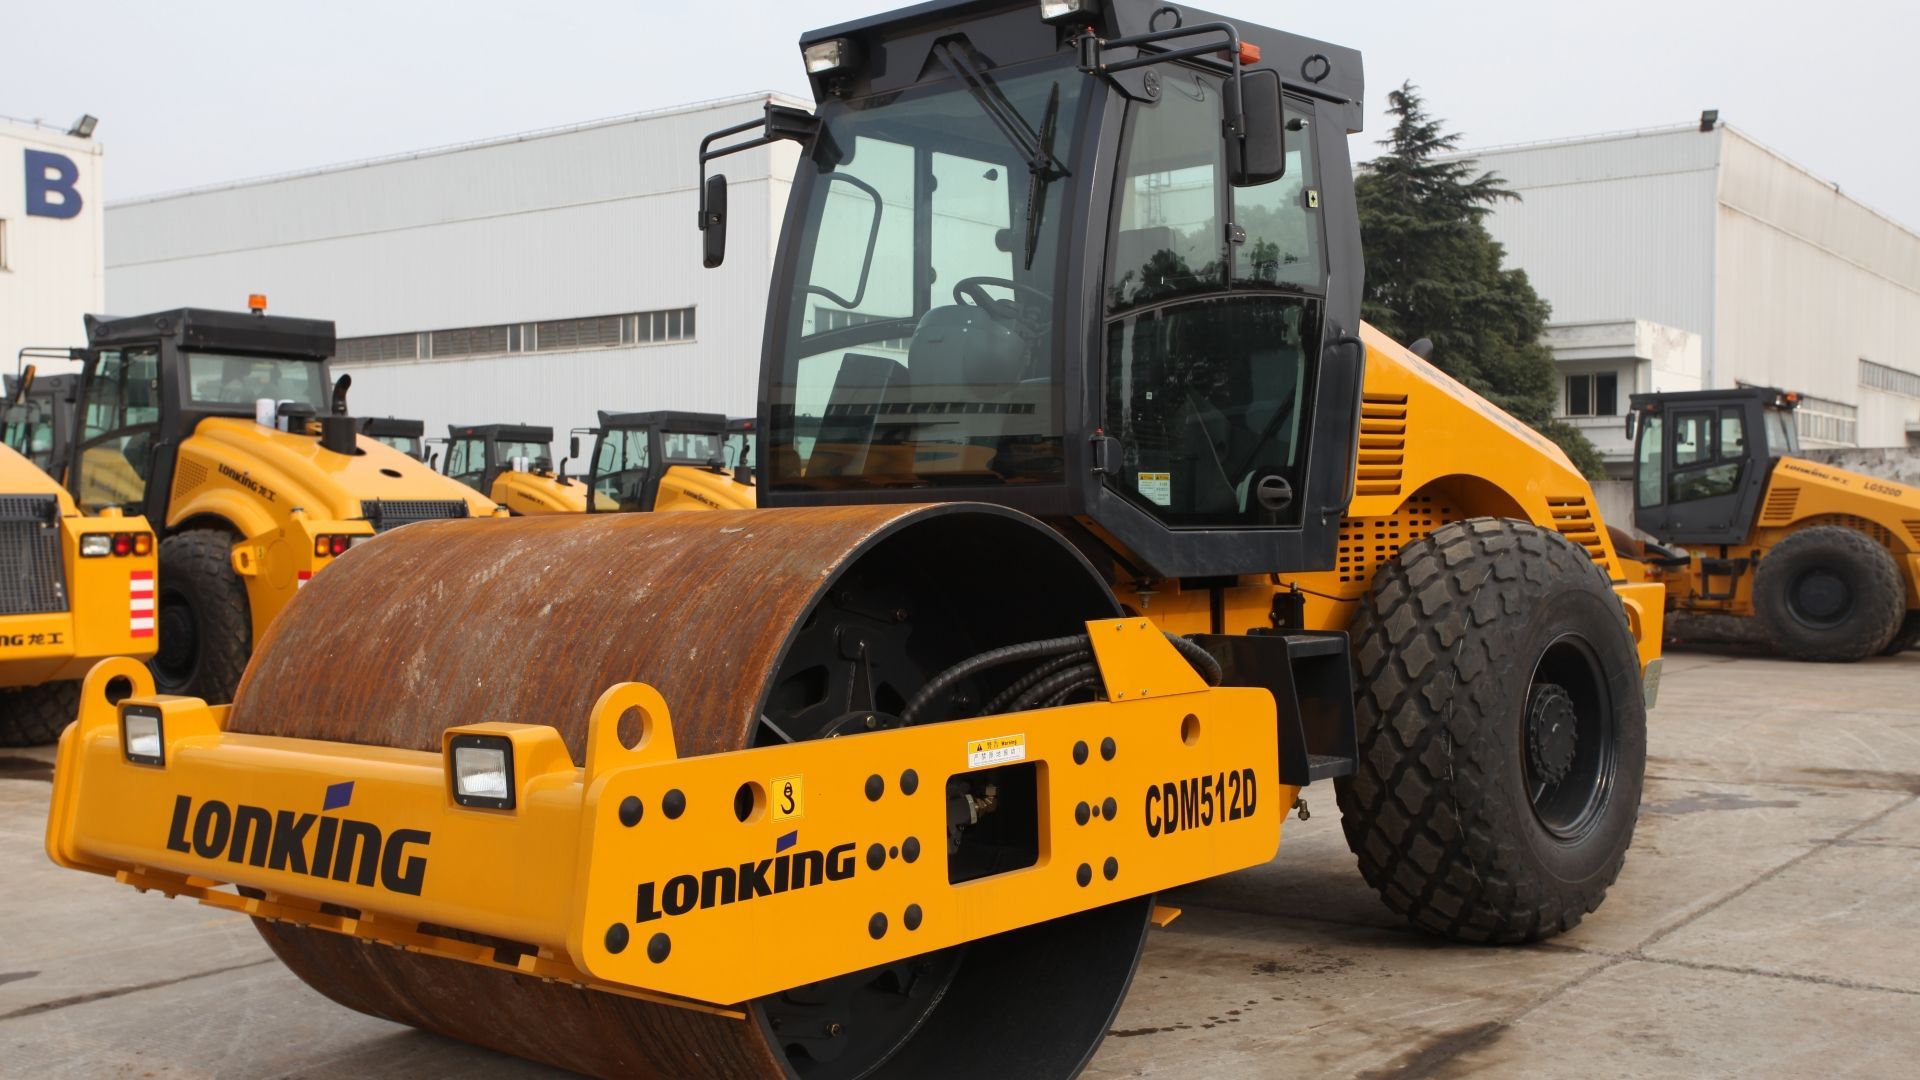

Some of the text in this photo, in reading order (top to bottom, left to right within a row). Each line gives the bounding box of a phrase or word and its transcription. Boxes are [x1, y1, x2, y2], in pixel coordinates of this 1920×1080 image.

[24, 148, 84, 219] B
[167, 781, 431, 896] LONKING
[1145, 768, 1257, 838] CDM512D
[636, 830, 856, 923] LONKING
